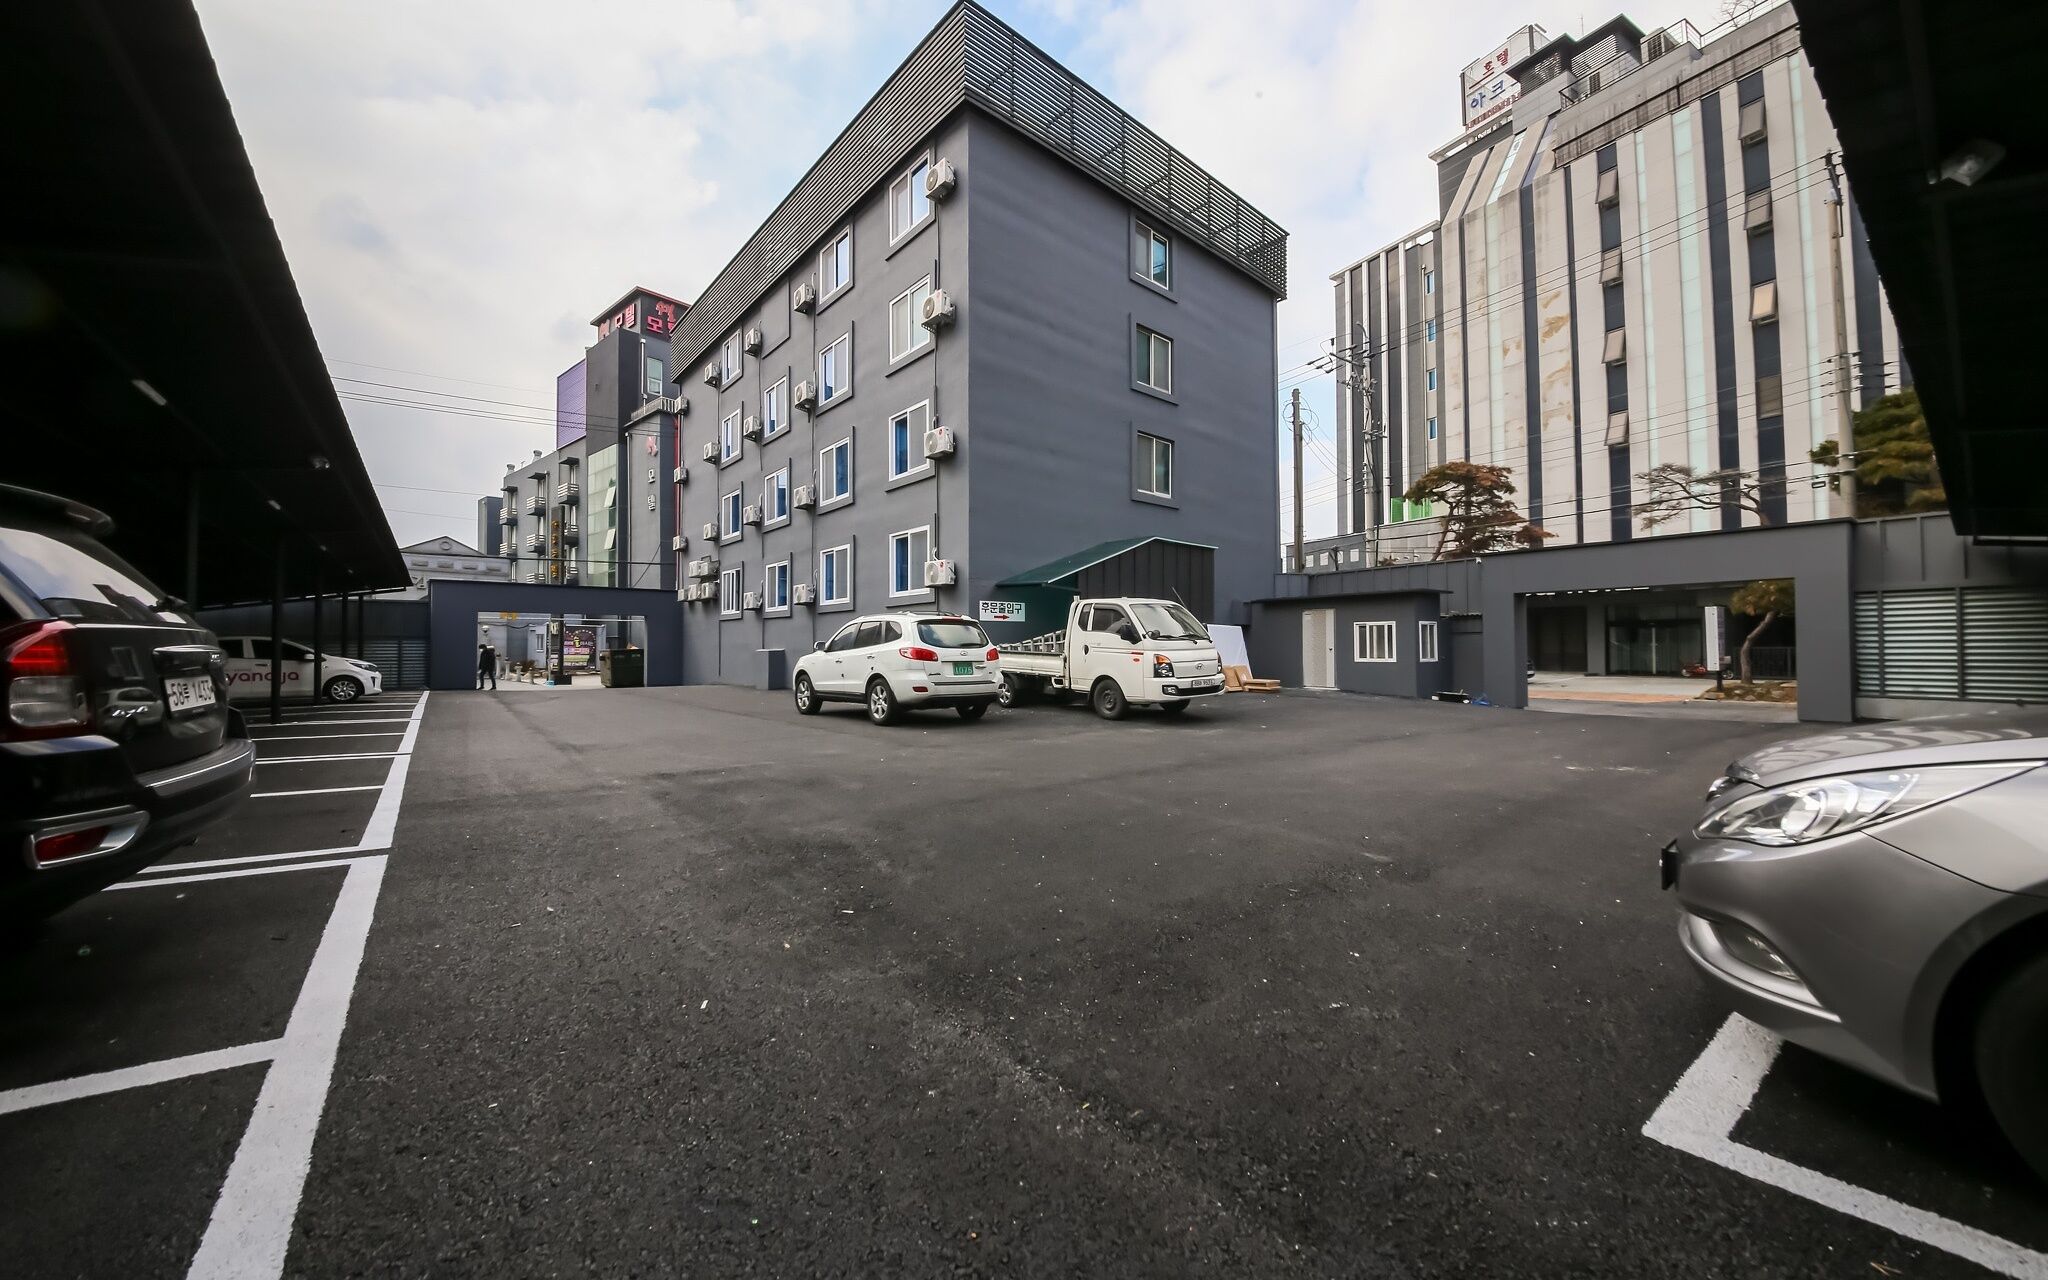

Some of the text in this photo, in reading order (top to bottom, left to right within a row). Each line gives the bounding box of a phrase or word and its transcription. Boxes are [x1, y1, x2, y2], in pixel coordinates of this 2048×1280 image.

[1470, 79, 1519, 108] 아크
[981, 601, 1022, 615] 후문출입구
[226, 671, 300, 686] yanoja
